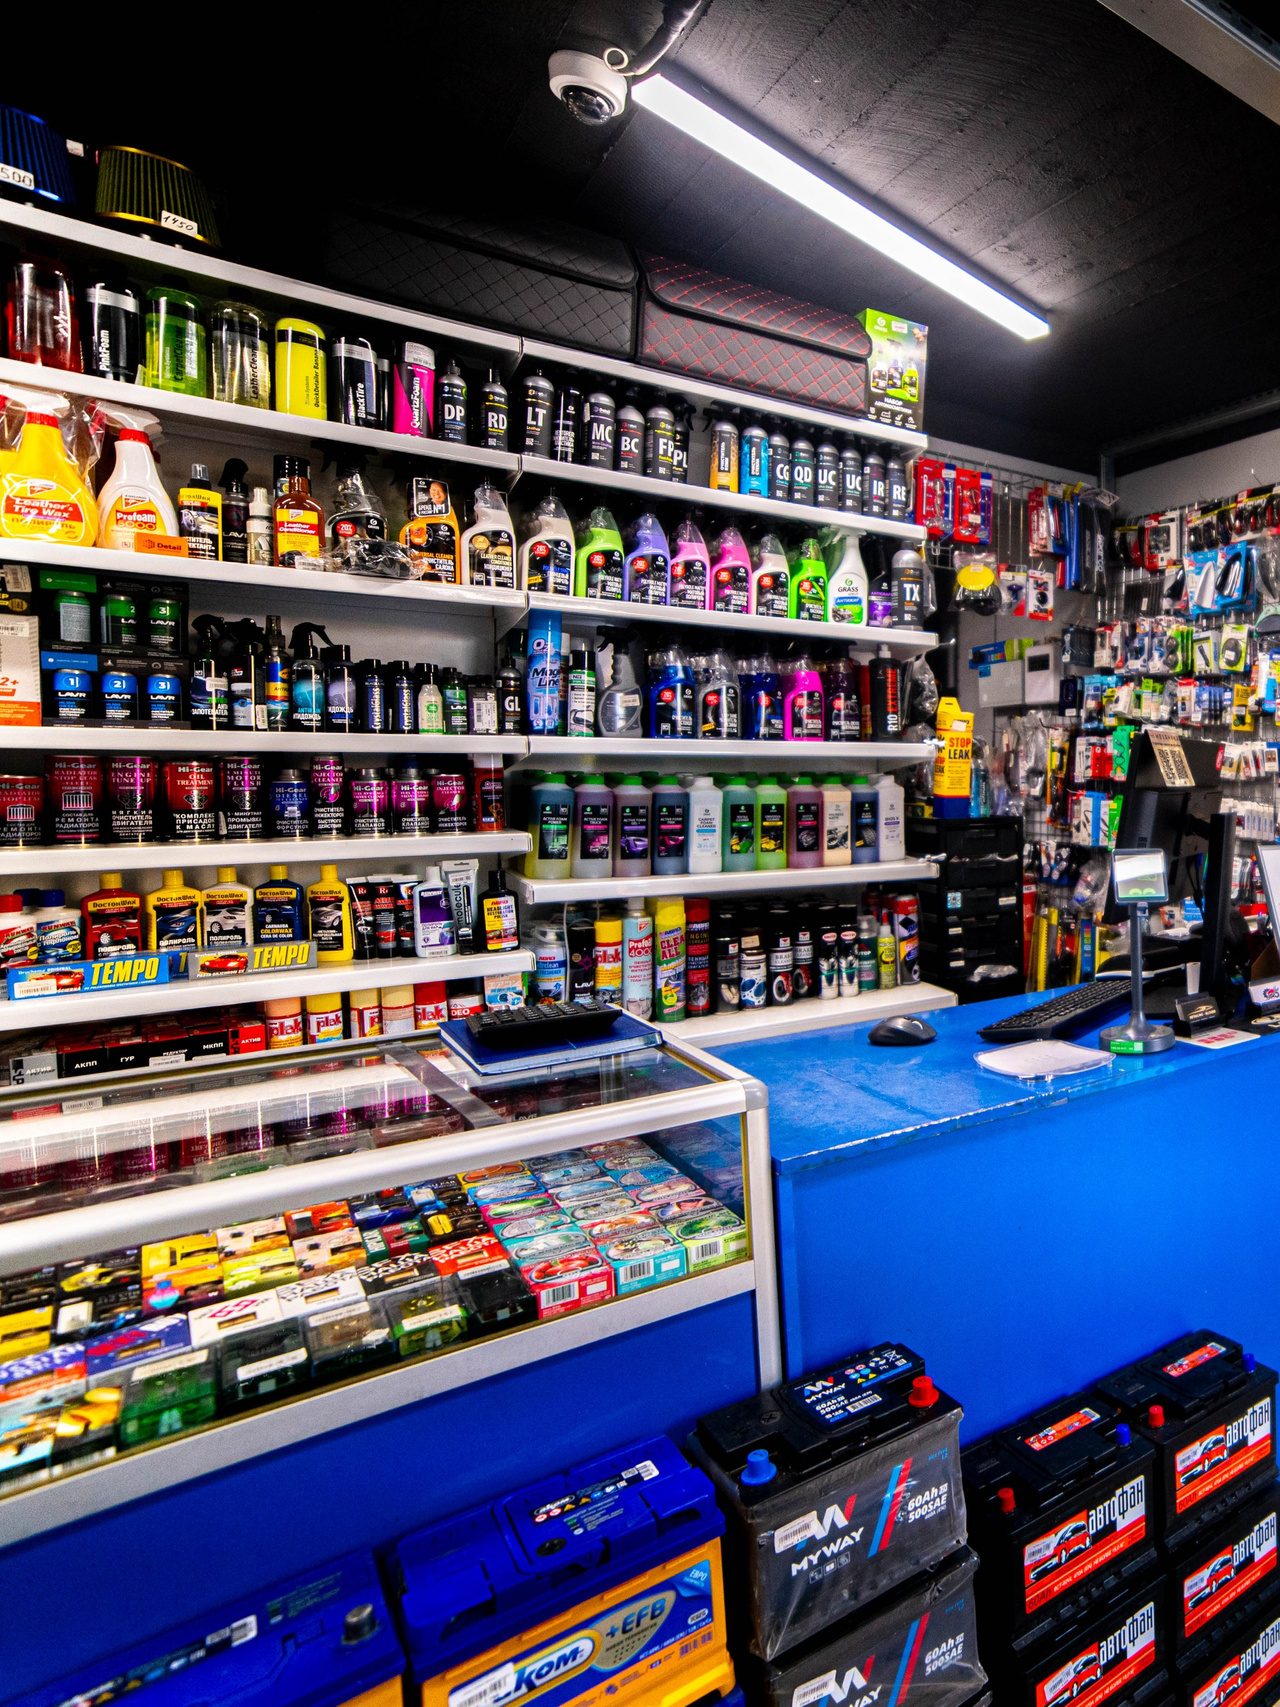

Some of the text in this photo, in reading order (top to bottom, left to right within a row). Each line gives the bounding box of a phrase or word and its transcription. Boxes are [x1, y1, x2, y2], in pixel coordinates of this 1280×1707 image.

[163, 214, 194, 231] 1450
[99, 330, 110, 371] PinkFoam
[357, 382, 365, 418] BlackTire
[411, 377, 420, 429] QuartzFoam
[884, 397, 903, 406] НАБОР
[444, 404, 465, 421] DP
[487, 411, 508, 430] RD
[526, 406, 546, 426] LT
[592, 423, 612, 443] MC
[621, 436, 639, 453] BC
[659, 437, 674, 457] FP
[673, 449, 687, 467] PL
[794, 466, 812, 482] QD
[818, 470, 836, 485] UC
[846, 475, 862, 490] UC
[873, 480, 884, 496] IR
[14, 505, 70, 518] Tire Wax
[117, 511, 156, 524] Profoam
[278, 527, 316, 535] Conditioner
[157, 542, 182, 551] Detail
[903, 585, 920, 601] TX
[372, 686, 381, 729] CrystalGlass
[403, 689, 412, 729] CrystalGlass
[504, 696, 520, 711] GL
[886, 669, 898, 731] R10 EXTREME
[949, 737, 971, 748] STOP
[948, 748, 970, 760] LEAK
[454, 884, 462, 925] molecule
[41, 921, 75, 932] RUNWAY
[159, 937, 195, 947] ПОЛИРОЛЬ
[209, 934, 242, 942] ПОЛИРОЛЬ
[660, 936, 685, 949] CLEA
[98, 944, 136, 953] ПОЛИРОЛЬ
[253, 943, 309, 971] TEMPO
[661, 947, 681, 960] ALL
[91, 957, 159, 986] TEMPO
[203, 1042, 224, 1050] МКПП
[75, 1060, 97, 1069] АКПП
[805, 1382, 846, 1404] MYWAY
[1226, 1401, 1270, 1448] автофан
[907, 1487, 938, 1512] 60Ah
[908, 1493, 948, 1523] 500SAE
[1088, 1480, 1145, 1535] автофан
[1233, 1517, 1277, 1568] автофан
[791, 1527, 864, 1577] MYWAY
[689, 1569, 708, 1581] ЕВРО
[606, 1597, 666, 1638] +EFB
[1100, 1607, 1154, 1666] автофан
[925, 1637, 954, 1665] 60Ah
[1240, 1622, 1280, 1676] автофан
[925, 1643, 963, 1676] 500SAE
[503, 1645, 580, 1697] КОМ
